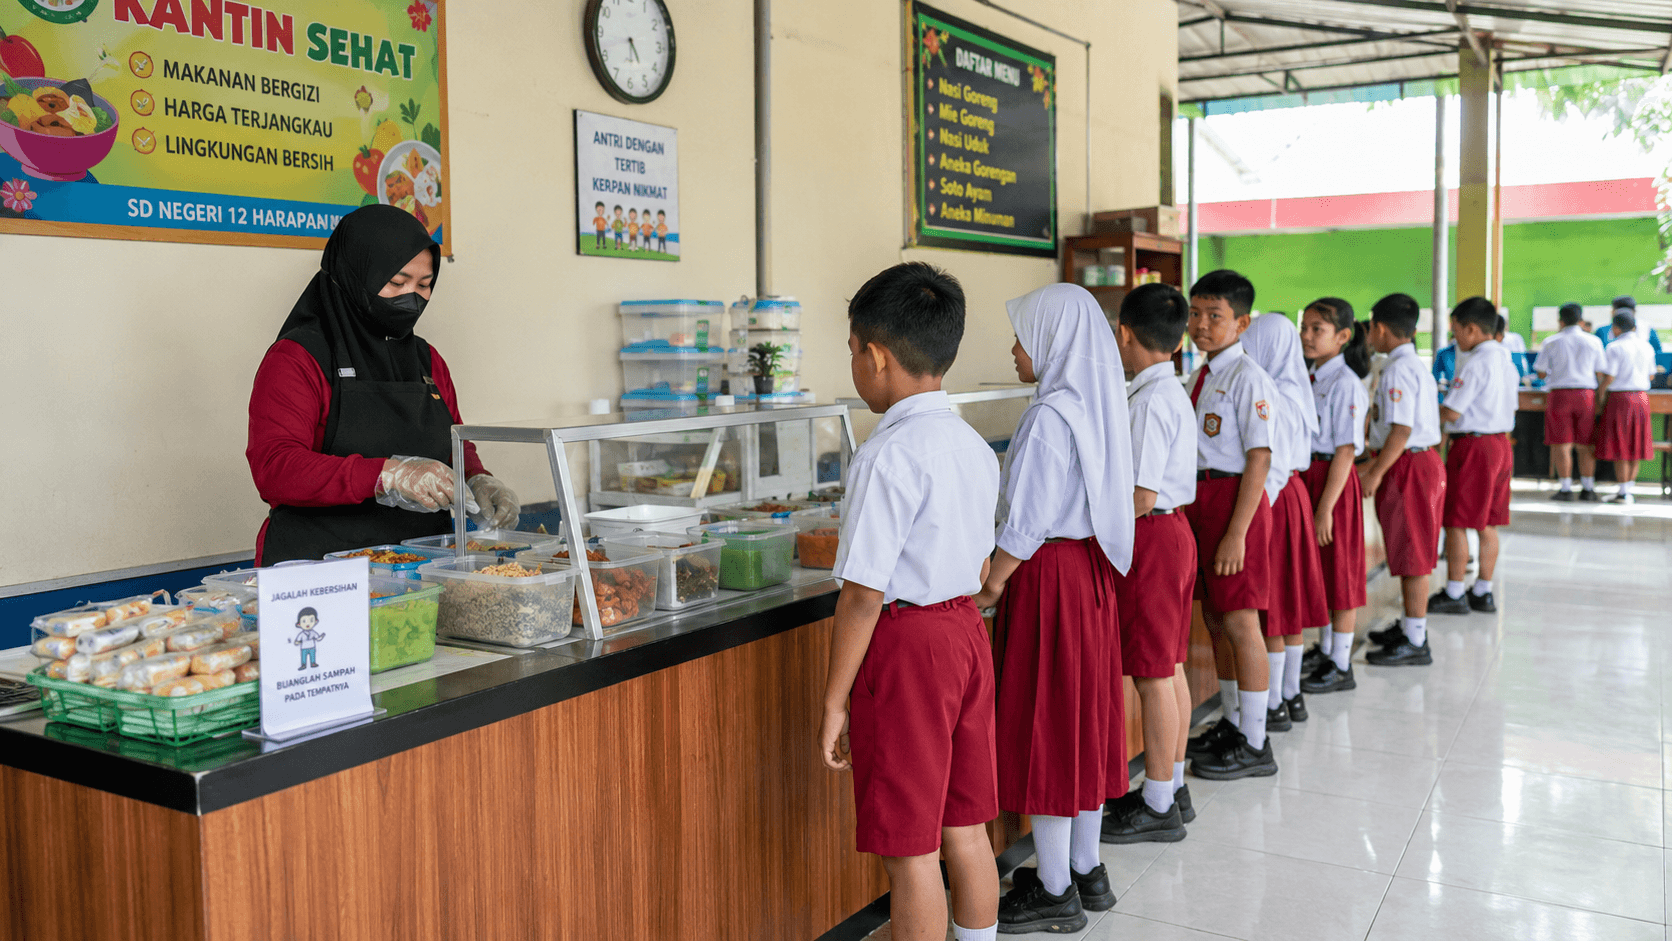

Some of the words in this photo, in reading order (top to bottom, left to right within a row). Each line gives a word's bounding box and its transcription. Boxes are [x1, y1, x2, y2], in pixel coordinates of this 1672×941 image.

[651, 18, 658, 31] 2
[306, 22, 416, 81] SEHAT
[655, 41, 662, 54] 3
[613, 66, 620, 81] 7
[651, 61, 658, 73] 4
[955, 46, 993, 78] DAFTAR
[994, 60, 1020, 87] MENU
[163, 59, 256, 92] MAKANAN
[261, 76, 320, 103] BERGIZI
[627, 77, 634, 90] 6
[642, 74, 648, 88] 5
[938, 77, 962, 99] Nasi
[963, 84, 998, 114] Goreng
[164, 97, 227, 124] HARGA
[230, 107, 333, 138] TERJANGKAU
[939, 102, 958, 123] Mie
[960, 108, 995, 137] Goreng
[593, 130, 623, 149] ANTRI
[626, 136, 664, 155] DENGAN
[939, 127, 963, 149] Nasi
[165, 135, 278, 166] LINGKUNGAN
[282, 149, 334, 172] BERSIH
[614, 156, 646, 175] TERTIB
[940, 153, 972, 175] Aneka
[973, 159, 1017, 187] Gorengan
[592, 177, 631, 196] KERPAN
[940, 177, 964, 198] Soto
[966, 181, 993, 204] Ayam
[127, 198, 153, 218] SD
[158, 200, 223, 224] NEGERI
[228, 207, 248, 225] 12
[252, 208, 329, 230] HARAPAN
[940, 202, 972, 222] Aneka
[271, 589, 308, 602] JAGALAH
[310, 583, 357, 596] KEBERSIHAN
[276, 674, 321, 690] BUANGLAH
[323, 667, 355, 680] SAMPAH
[284, 691, 306, 703] PADA
[307, 682, 349, 697] TEMPATNYA
